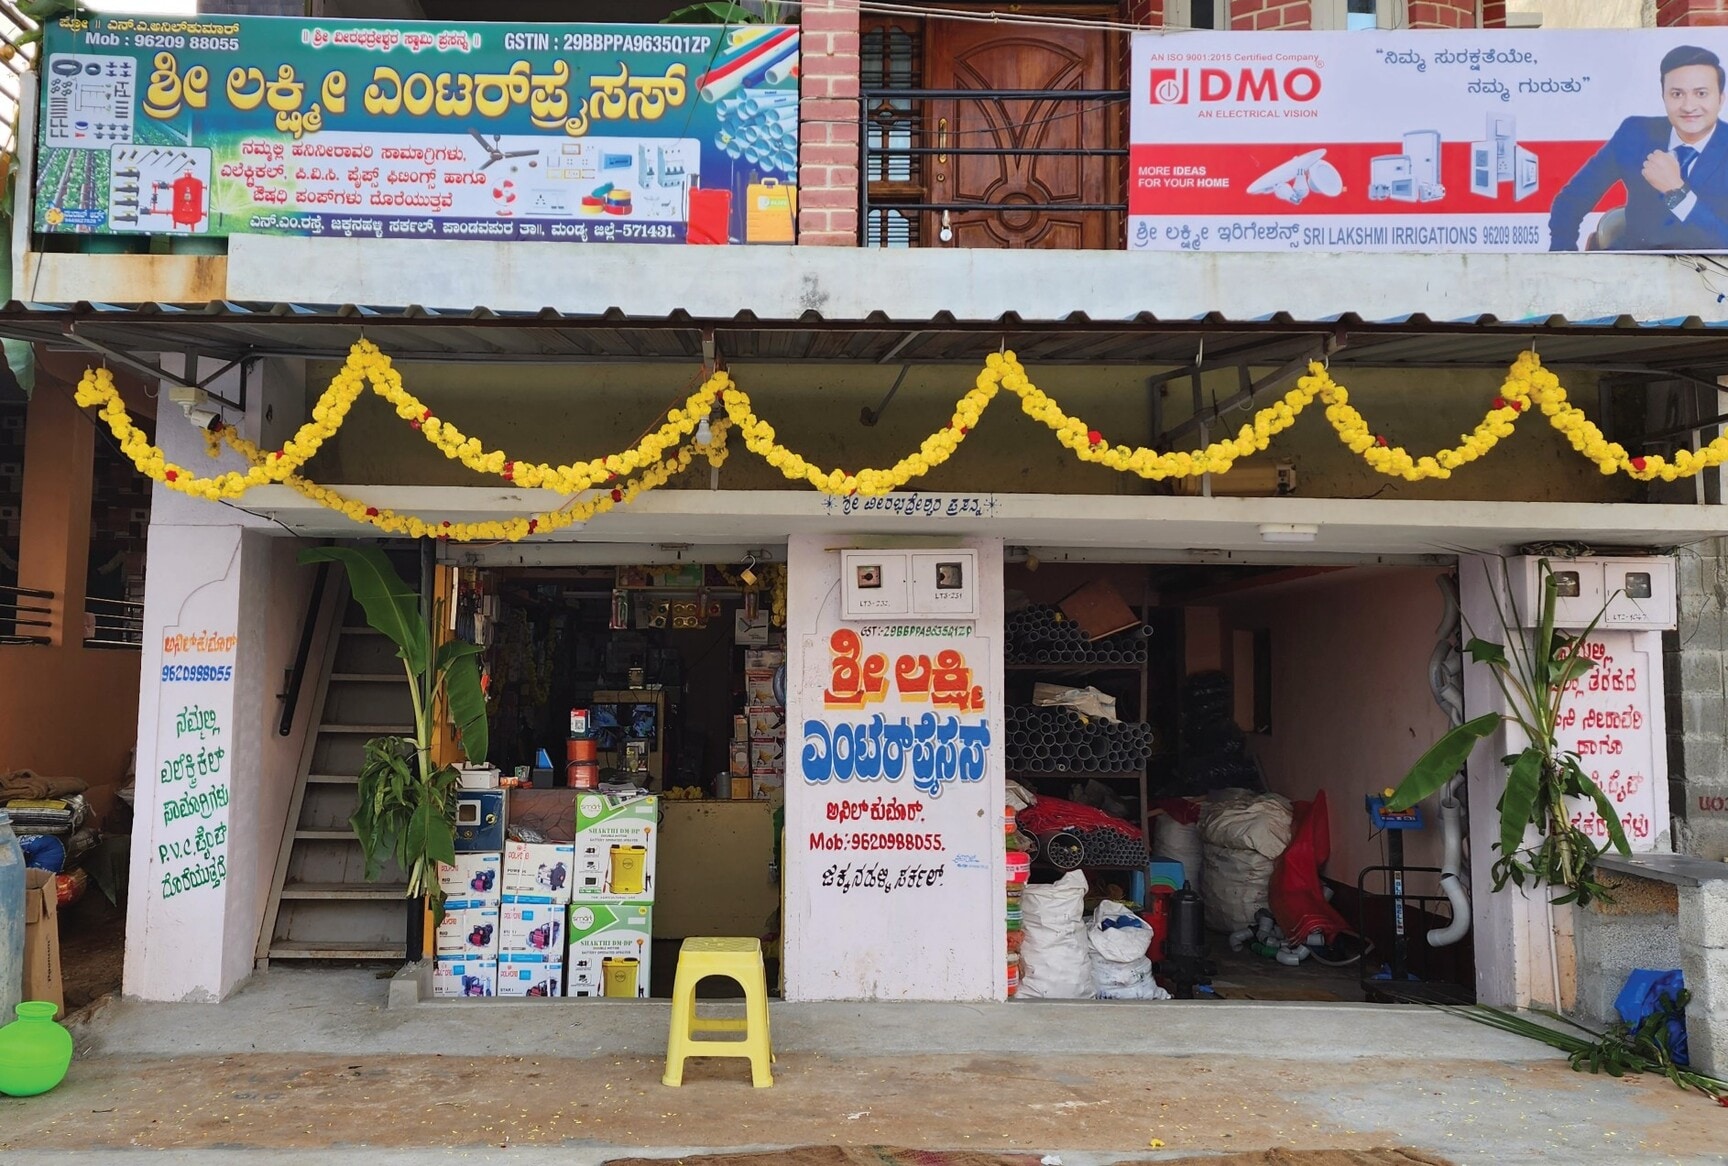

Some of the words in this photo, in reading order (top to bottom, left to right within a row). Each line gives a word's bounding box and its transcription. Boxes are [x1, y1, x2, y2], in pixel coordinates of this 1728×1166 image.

[85, 31, 121, 46] Mob
[134, 34, 185, 49] 96209
[189, 36, 240, 50] 88055
[313, 29, 328, 46] ಶ್ರೀ
[404, 32, 432, 50] ಸ್ವಾಮಿ
[438, 31, 469, 50] ಪ್ರಸನ್ನ
[504, 32, 549, 50] GSTIN
[563, 33, 711, 54] 29BBPPA9635Q1ZP
[1151, 53, 1167, 61] AN
[1167, 53, 1183, 62] ISO
[1186, 53, 1232, 62] 9001:2015
[1234, 53, 1274, 62] Certified
[1275, 53, 1320, 64] Company
[142, 50, 209, 119] ಶ್ರೀ
[226, 63, 348, 139] ಲಕ್ಷ್ಮೀ
[1200, 66, 1322, 103] DMO
[1467, 77, 1511, 102] ನಮ್ಮ
[1198, 109, 1213, 118] AN
[1215, 109, 1280, 118] ELECTRICAL
[1283, 109, 1319, 118] VISION
[242, 139, 285, 162] ನಮ್ಮಲ್ಲಿ
[292, 142, 374, 159] ಹನಿನೀರಾವರಿ
[444, 169, 487, 184] ಹಾಗೂ
[1138, 166, 1171, 176] MORE
[1173, 166, 1207, 176] IDEAS
[1138, 178, 1161, 188] FOR
[1163, 178, 1195, 188] YOUR
[1197, 178, 1230, 188] HOME
[253, 185, 288, 205] ಔಷಧಿ
[370, 190, 453, 213] ದೊರೆಯುತ್ತವೆ
[1134, 221, 1157, 248] ಶ್ರೀ
[1303, 226, 1325, 245] SRI
[1328, 226, 1388, 246] LAKSHMI
[1391, 226, 1478, 245] IRRIGATIONS
[1483, 225, 1510, 245] 96209
[1512, 225, 1540, 245] 88055
[824, 628, 890, 710] ಶ್ರೀ
